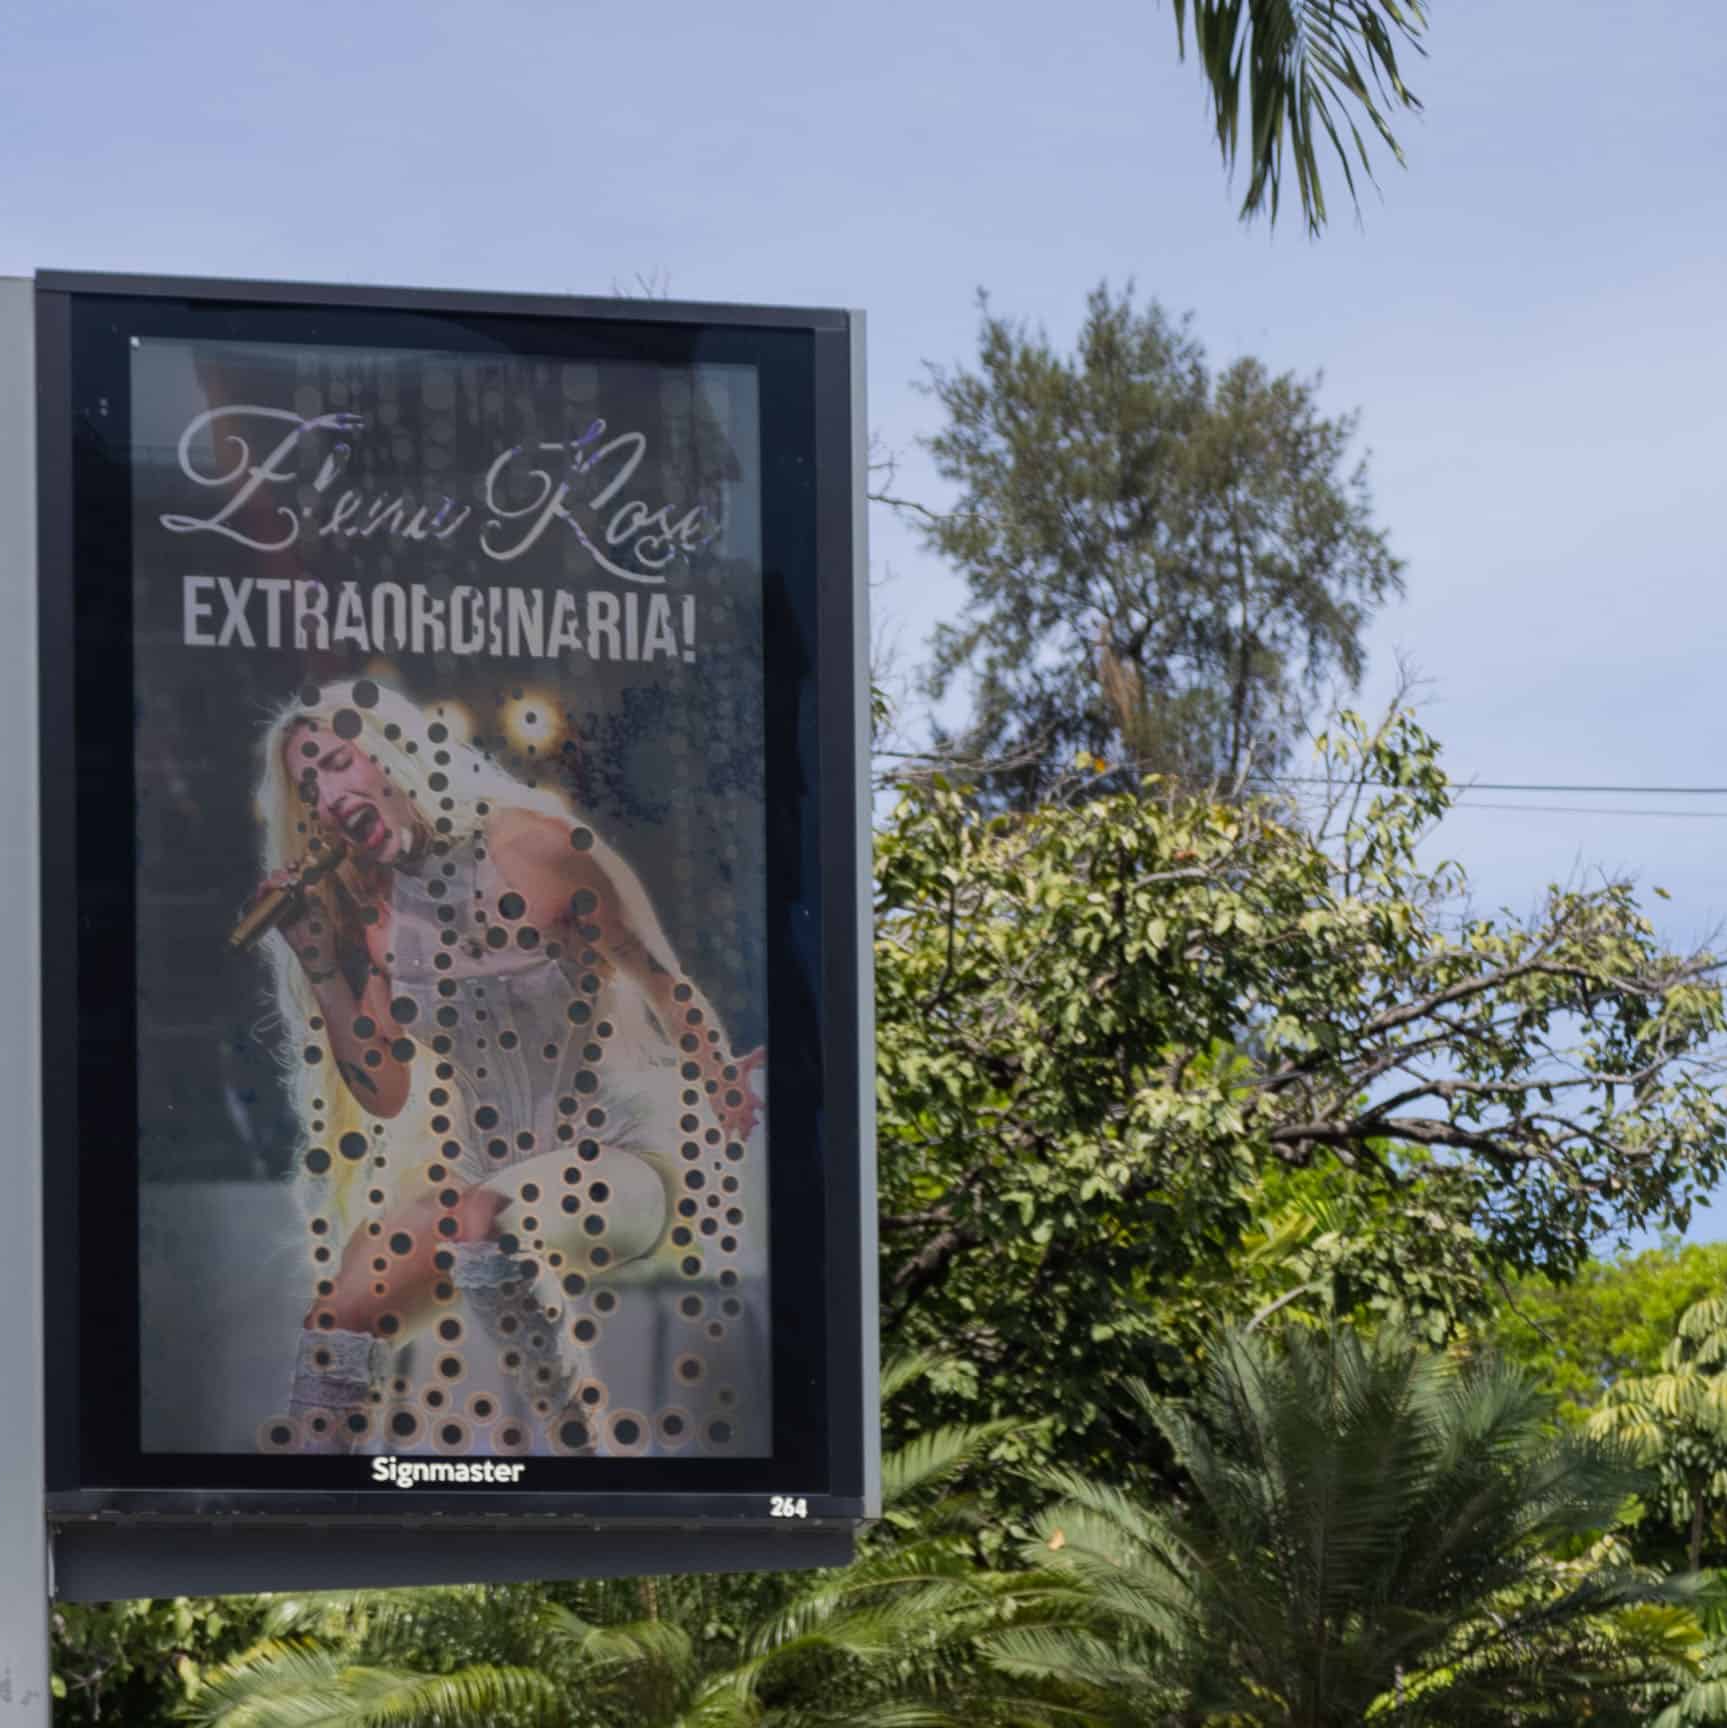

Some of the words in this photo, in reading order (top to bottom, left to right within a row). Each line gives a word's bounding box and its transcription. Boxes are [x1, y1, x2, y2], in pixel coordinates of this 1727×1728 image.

[182, 575, 697, 663] EXTRAORDINARIA!
[372, 1456, 526, 1488] Signmaster
[770, 1496, 808, 1518] 264
